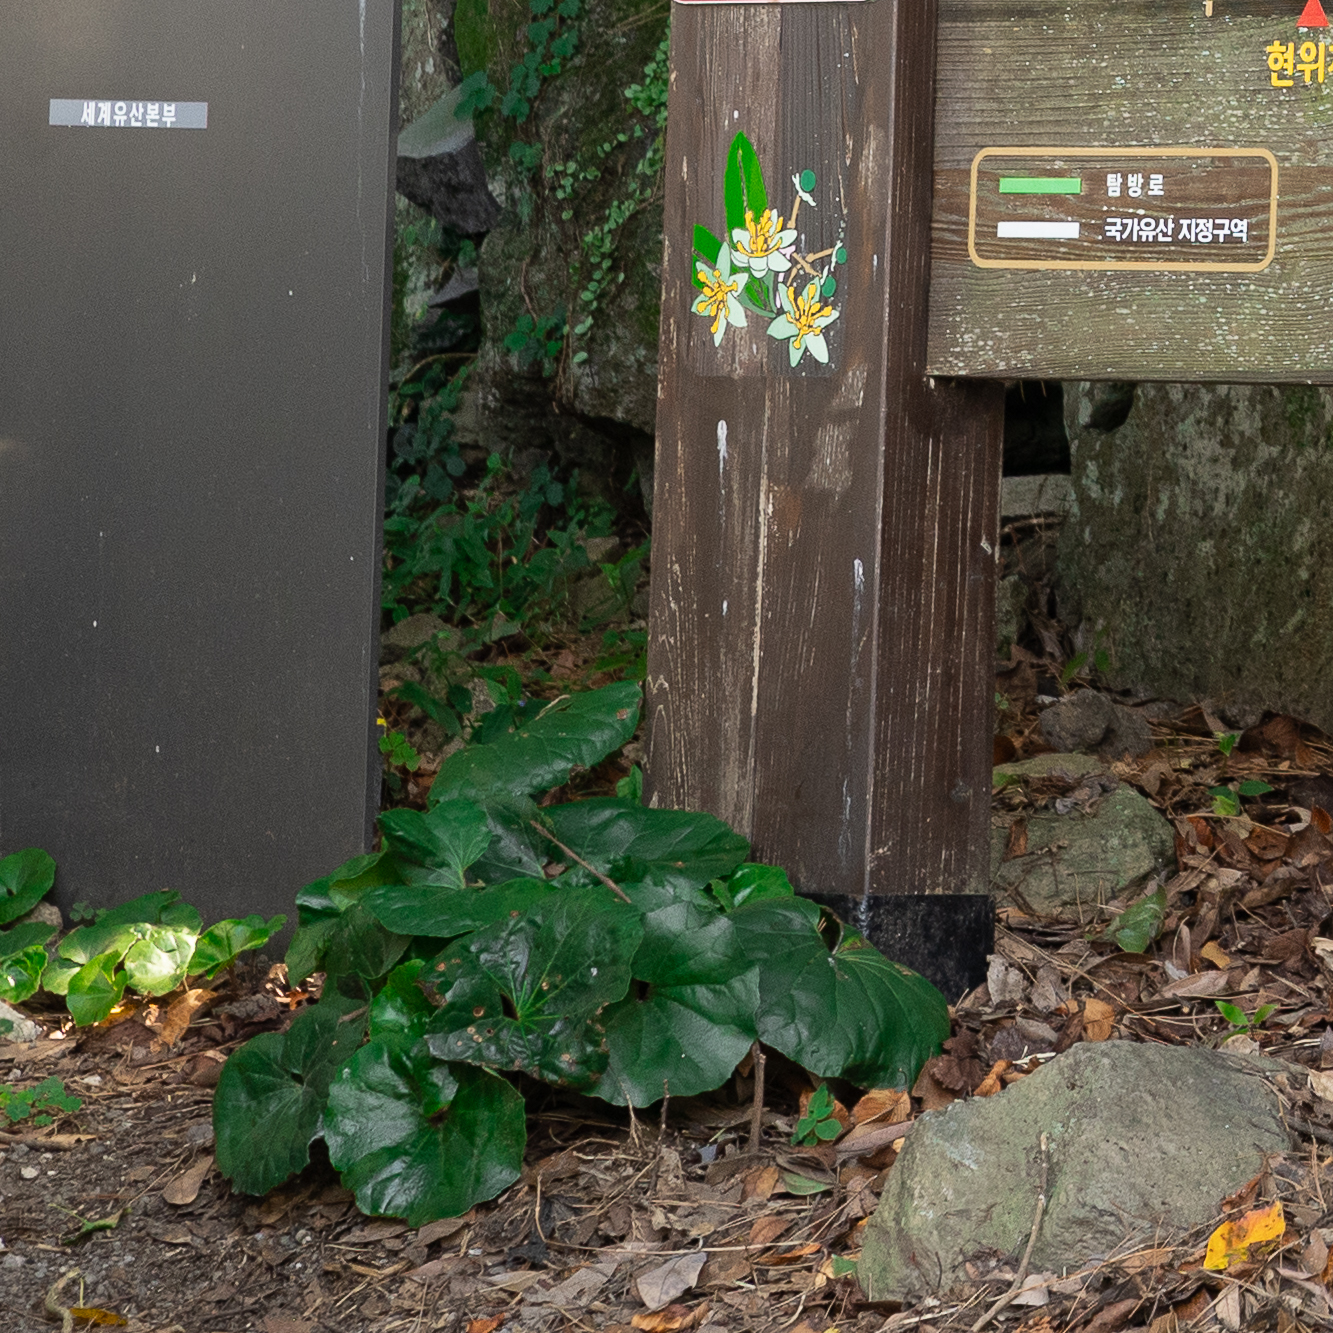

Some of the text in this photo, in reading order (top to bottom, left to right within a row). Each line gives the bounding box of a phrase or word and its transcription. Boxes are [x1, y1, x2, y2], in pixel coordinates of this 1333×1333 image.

[80, 100, 177, 128] 세계유산본부
[1105, 217, 1248, 243] 국가유산 지정구역
